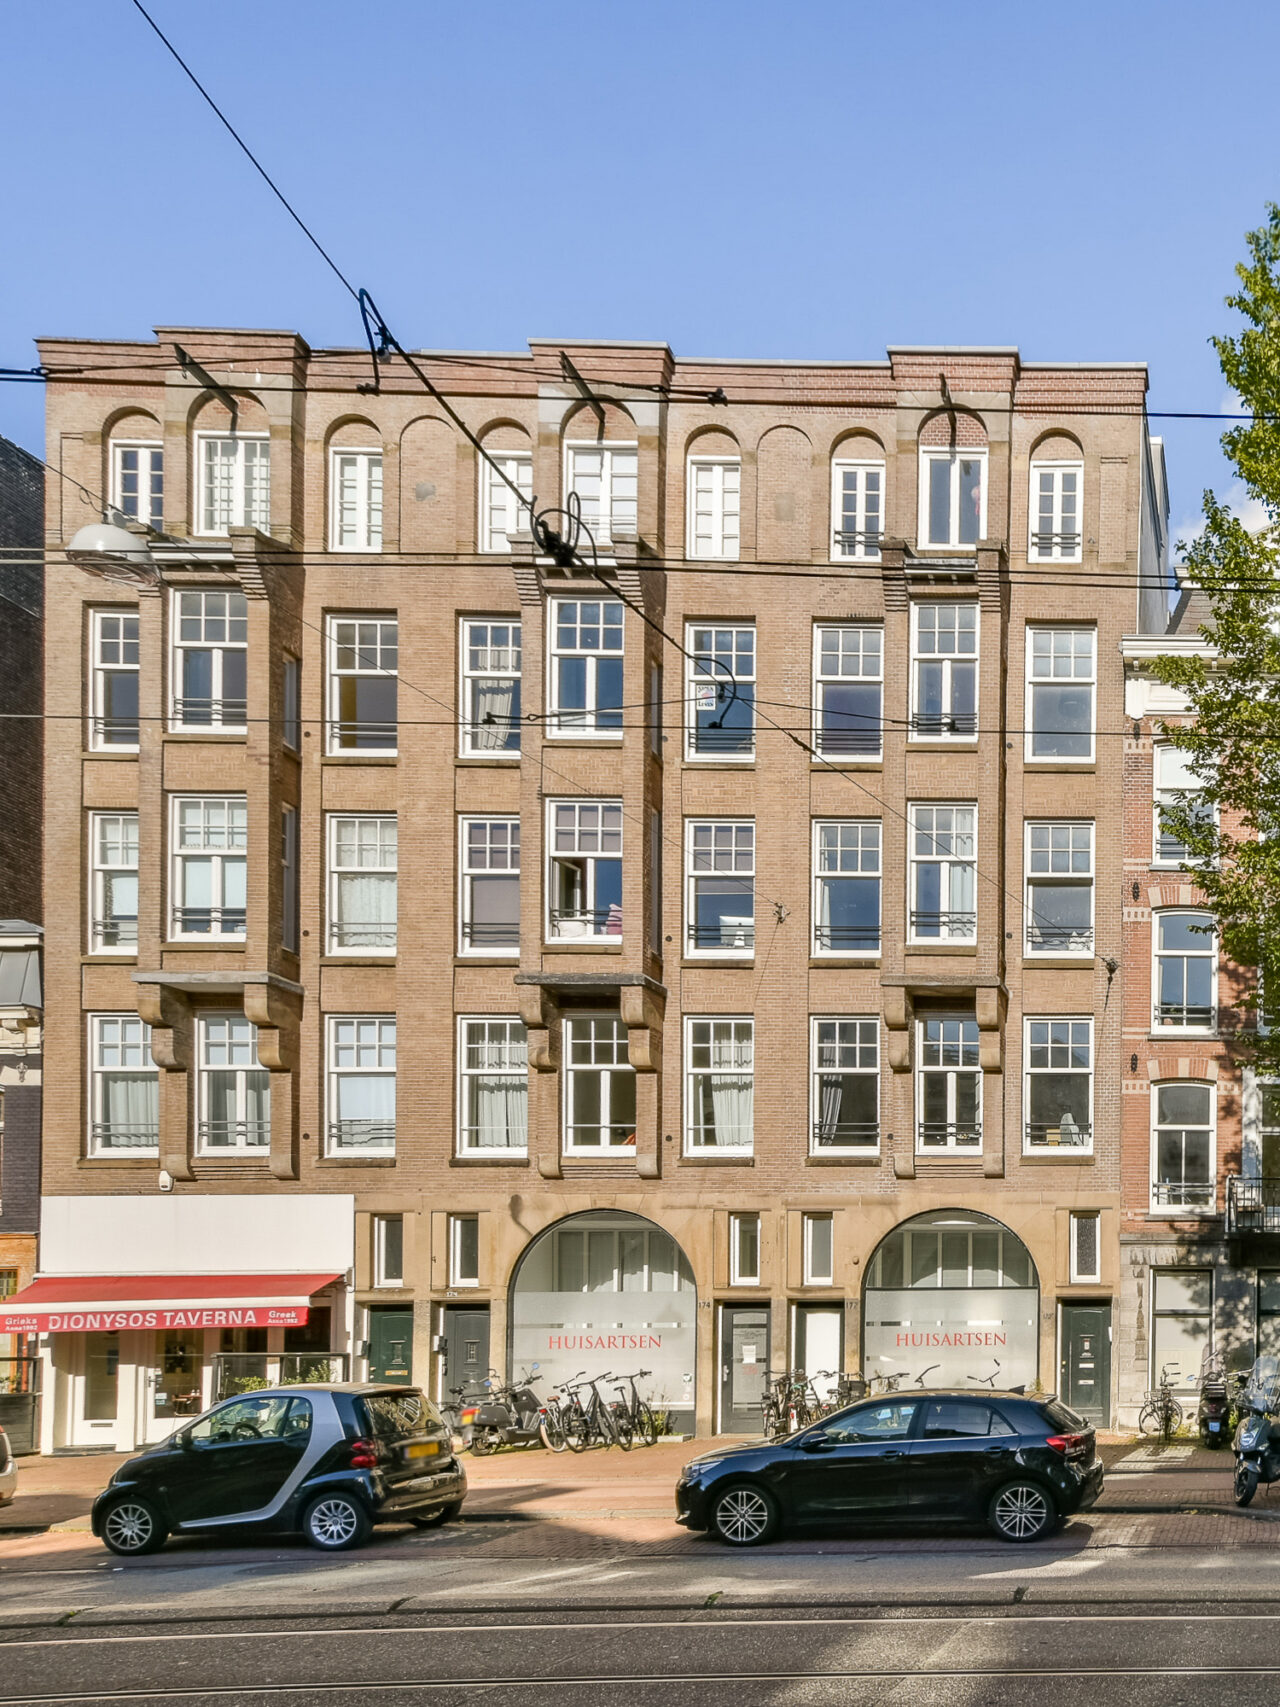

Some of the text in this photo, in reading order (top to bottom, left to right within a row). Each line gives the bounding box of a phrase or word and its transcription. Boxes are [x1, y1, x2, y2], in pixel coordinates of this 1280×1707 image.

[5, 1317, 38, 1325] Grieks
[48, 1310, 257, 1330] DIONYSOS TAVERNA
[268, 1310, 297, 1318] Greek
[549, 1335, 662, 1349] HUISARTSEN
[896, 1332, 1006, 1346] HUISARTSEN
